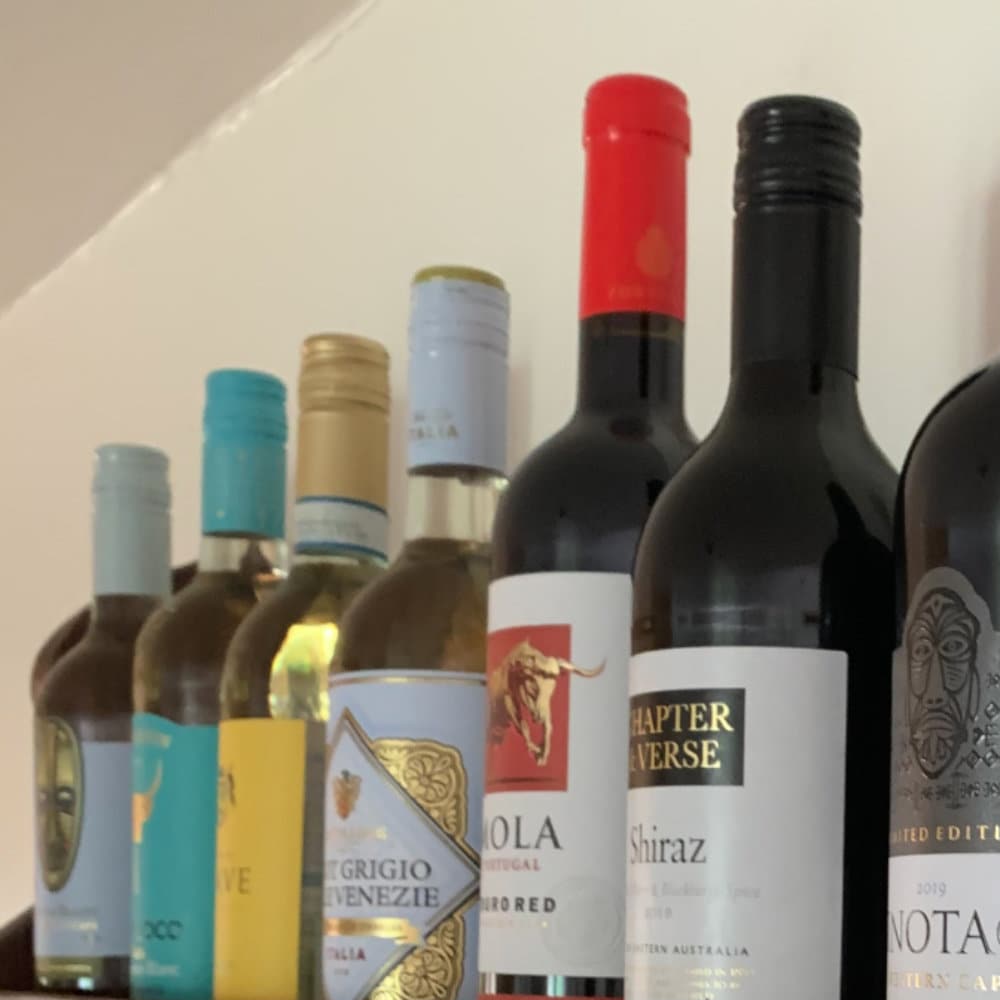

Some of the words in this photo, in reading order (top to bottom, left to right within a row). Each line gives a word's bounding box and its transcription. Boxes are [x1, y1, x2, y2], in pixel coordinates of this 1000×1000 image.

[637, 739, 722, 769] VERSE
[630, 823, 707, 865] Shiraz
[340, 858, 433, 882] GRIGIO
[514, 896, 557, 913] RED
[673, 943, 750, 957] AUSTRALIA
